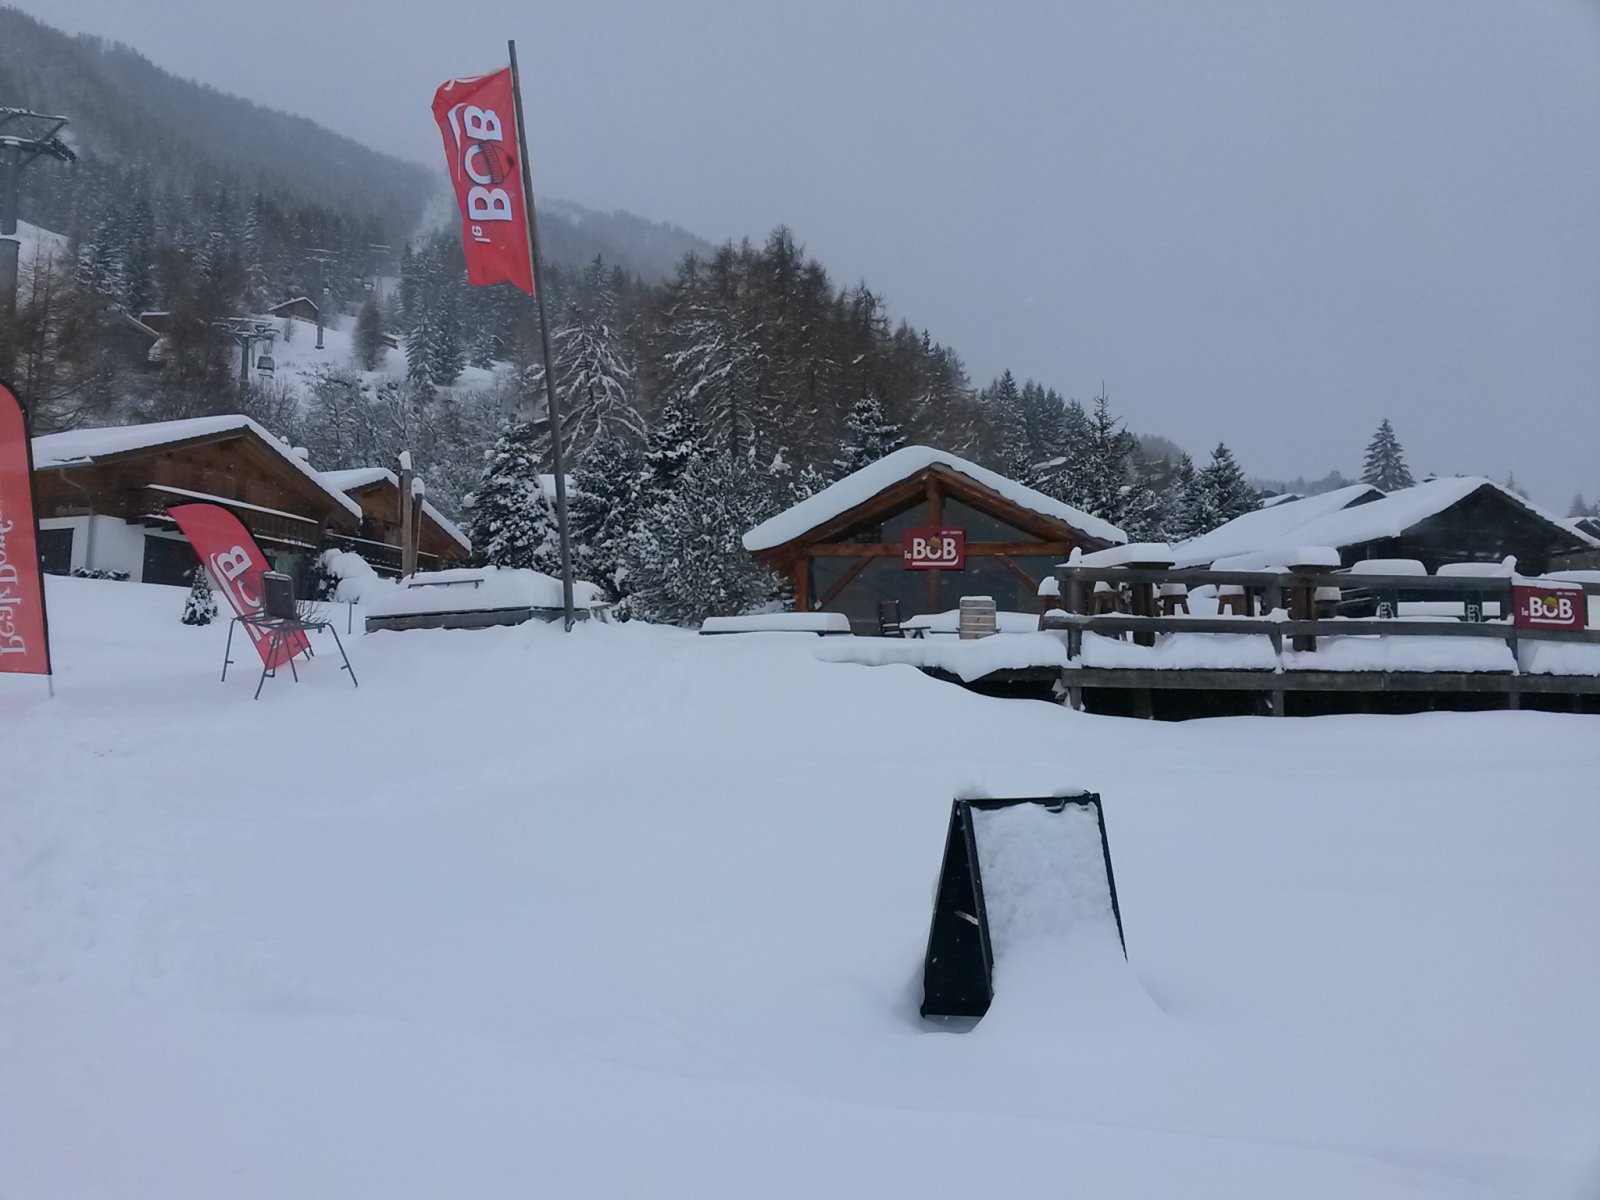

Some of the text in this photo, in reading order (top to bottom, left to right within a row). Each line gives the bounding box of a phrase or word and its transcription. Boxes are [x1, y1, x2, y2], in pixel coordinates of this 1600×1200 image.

[904, 537, 957, 560] le BOB
[1521, 596, 1573, 619] le BOB
